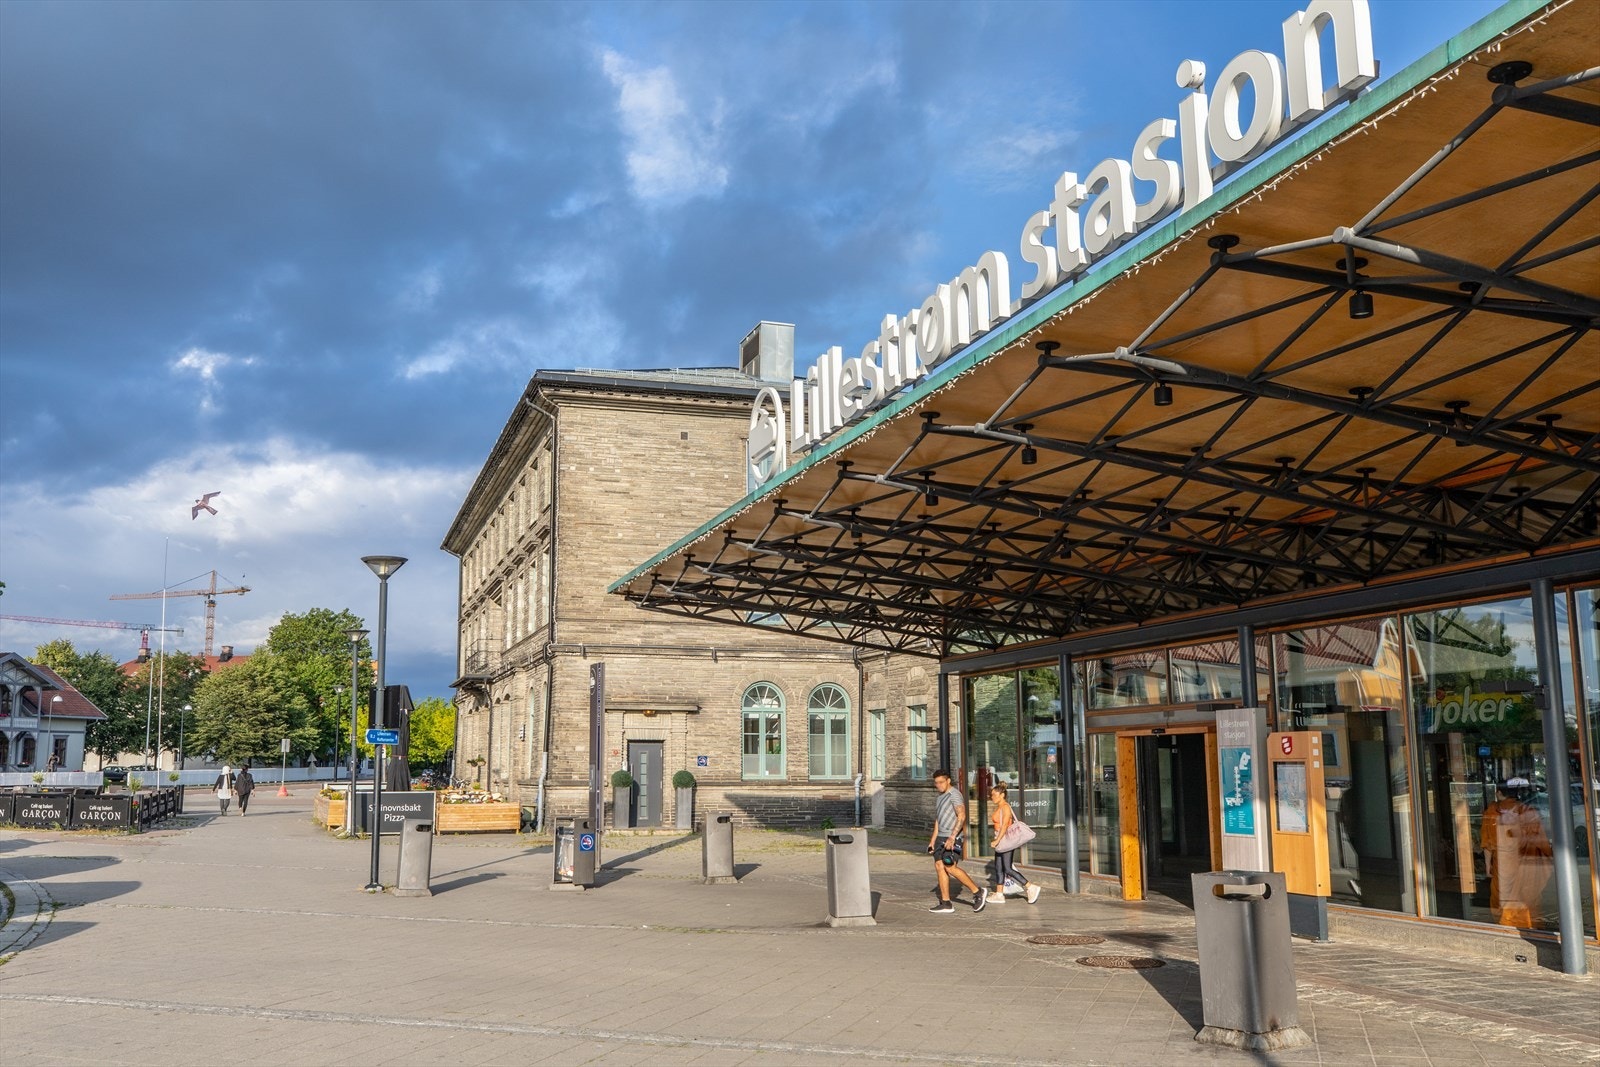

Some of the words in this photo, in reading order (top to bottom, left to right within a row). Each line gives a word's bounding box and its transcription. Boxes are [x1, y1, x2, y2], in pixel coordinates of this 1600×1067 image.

[790, 250, 1011, 453] Lillestrøm
[1020, 0, 1376, 300] stasjon
[1428, 686, 1513, 733] joker
[368, 803, 422, 812] Sinovnsbakt
[22, 809, 61, 819] GARÇON
[80, 811, 121, 821] GARÇON
